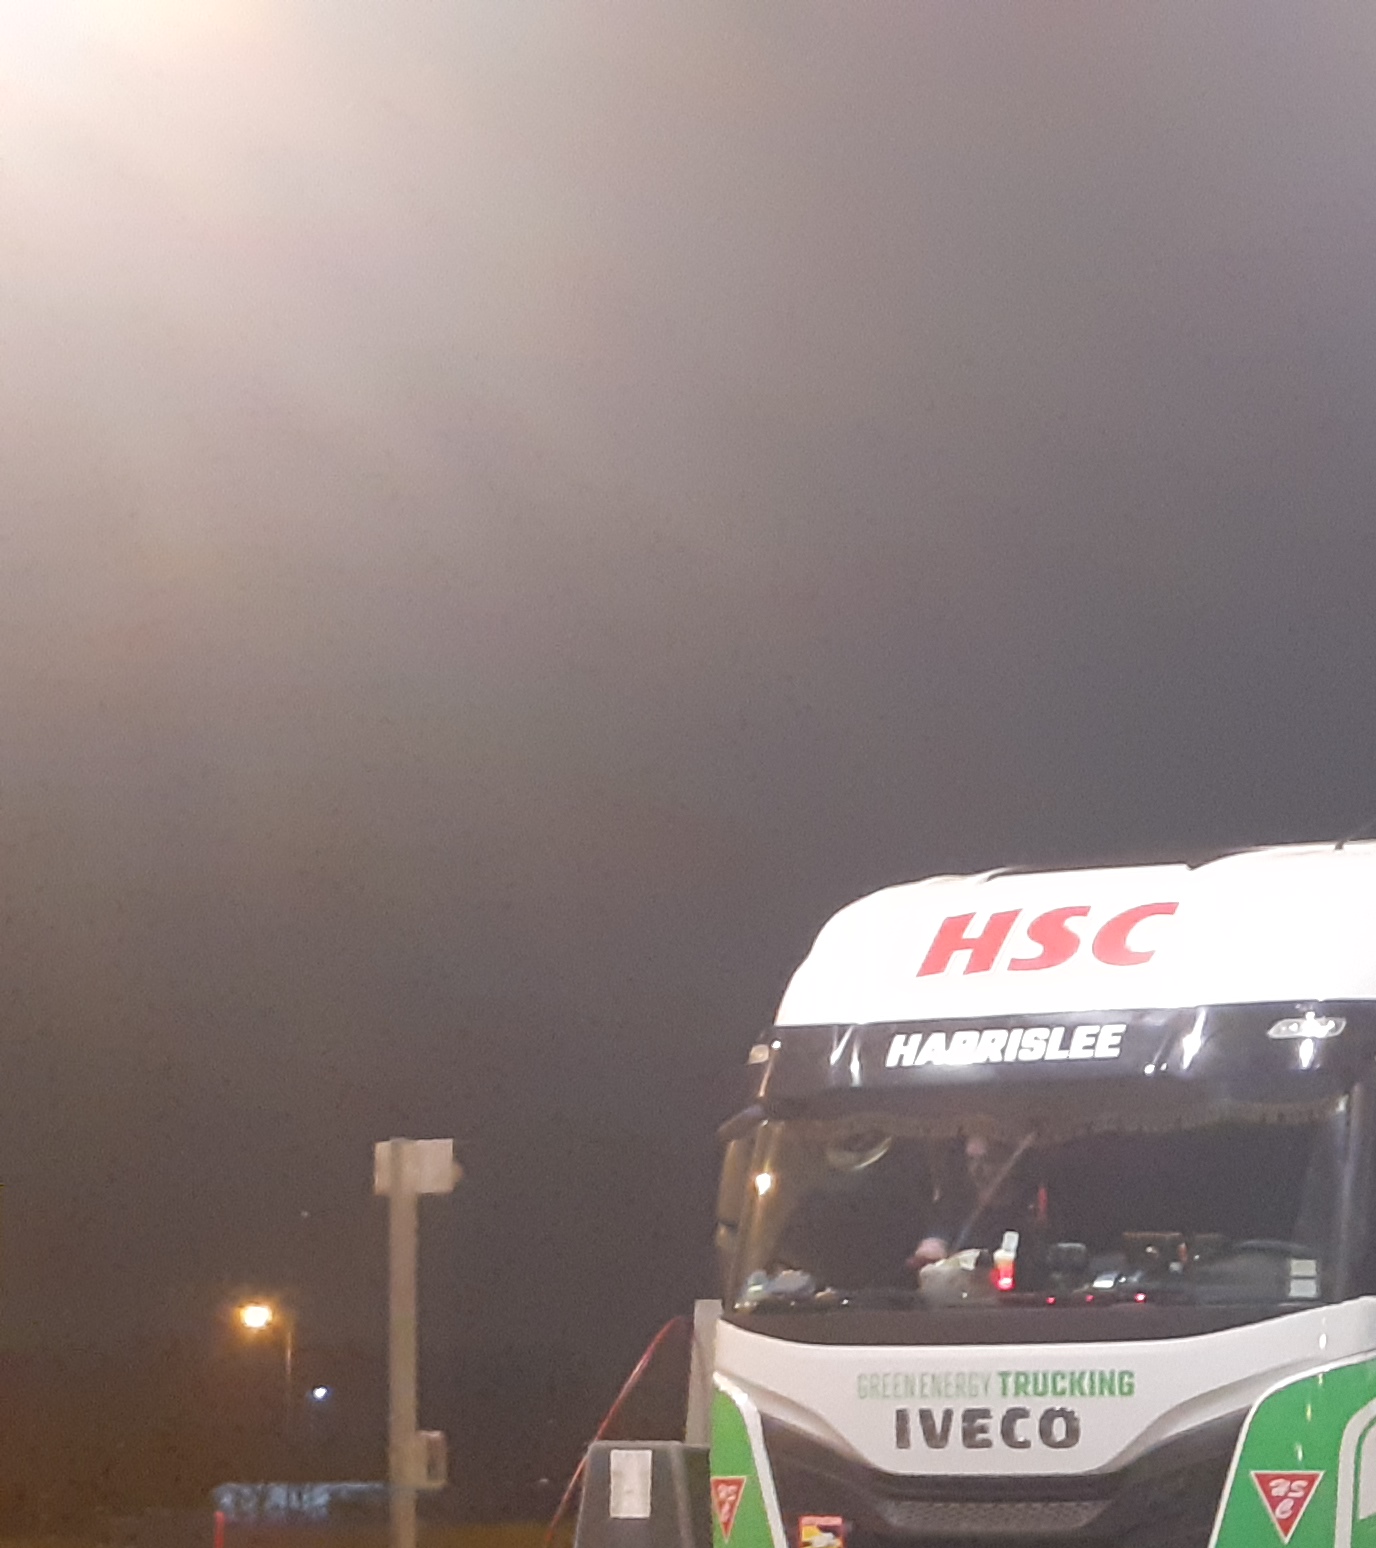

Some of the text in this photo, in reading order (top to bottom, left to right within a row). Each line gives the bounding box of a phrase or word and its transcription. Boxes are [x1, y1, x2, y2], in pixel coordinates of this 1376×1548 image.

[916, 902, 1179, 977] HSC
[857, 1369, 1135, 1400] GREEN ENERGY TRUCKING
[895, 1406, 1081, 1450] IVECO
